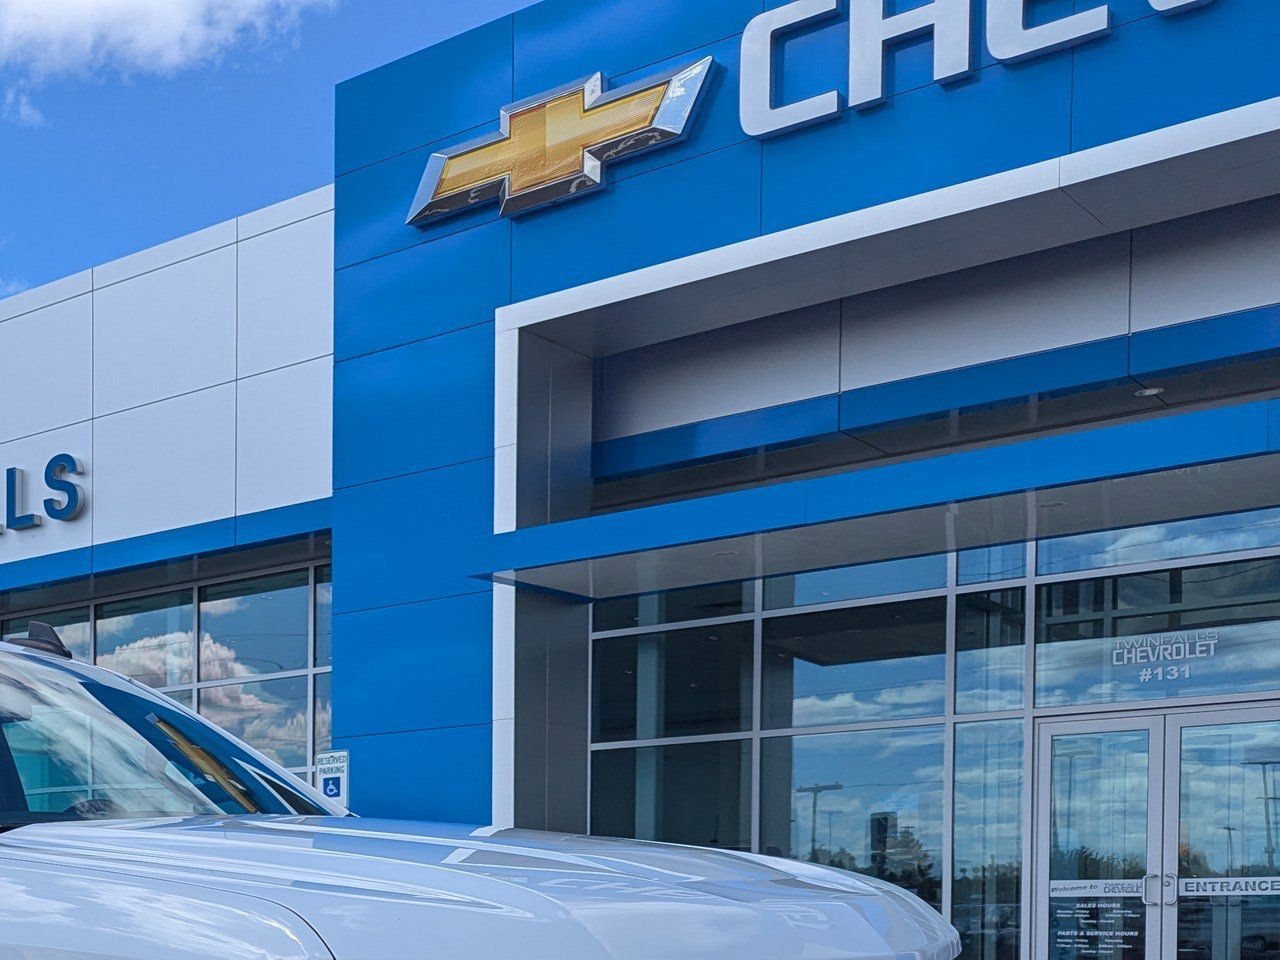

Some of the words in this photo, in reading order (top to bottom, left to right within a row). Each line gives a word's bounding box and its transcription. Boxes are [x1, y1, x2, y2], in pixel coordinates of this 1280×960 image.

[739, 0, 1216, 138] CH
[1112, 640, 1219, 665] CHEVROLET
[1139, 664, 1191, 683] #131
[318, 756, 346, 765] RESERVED
[319, 766, 345, 775] PARKING
[1184, 880, 1280, 893] ENTRANCE
